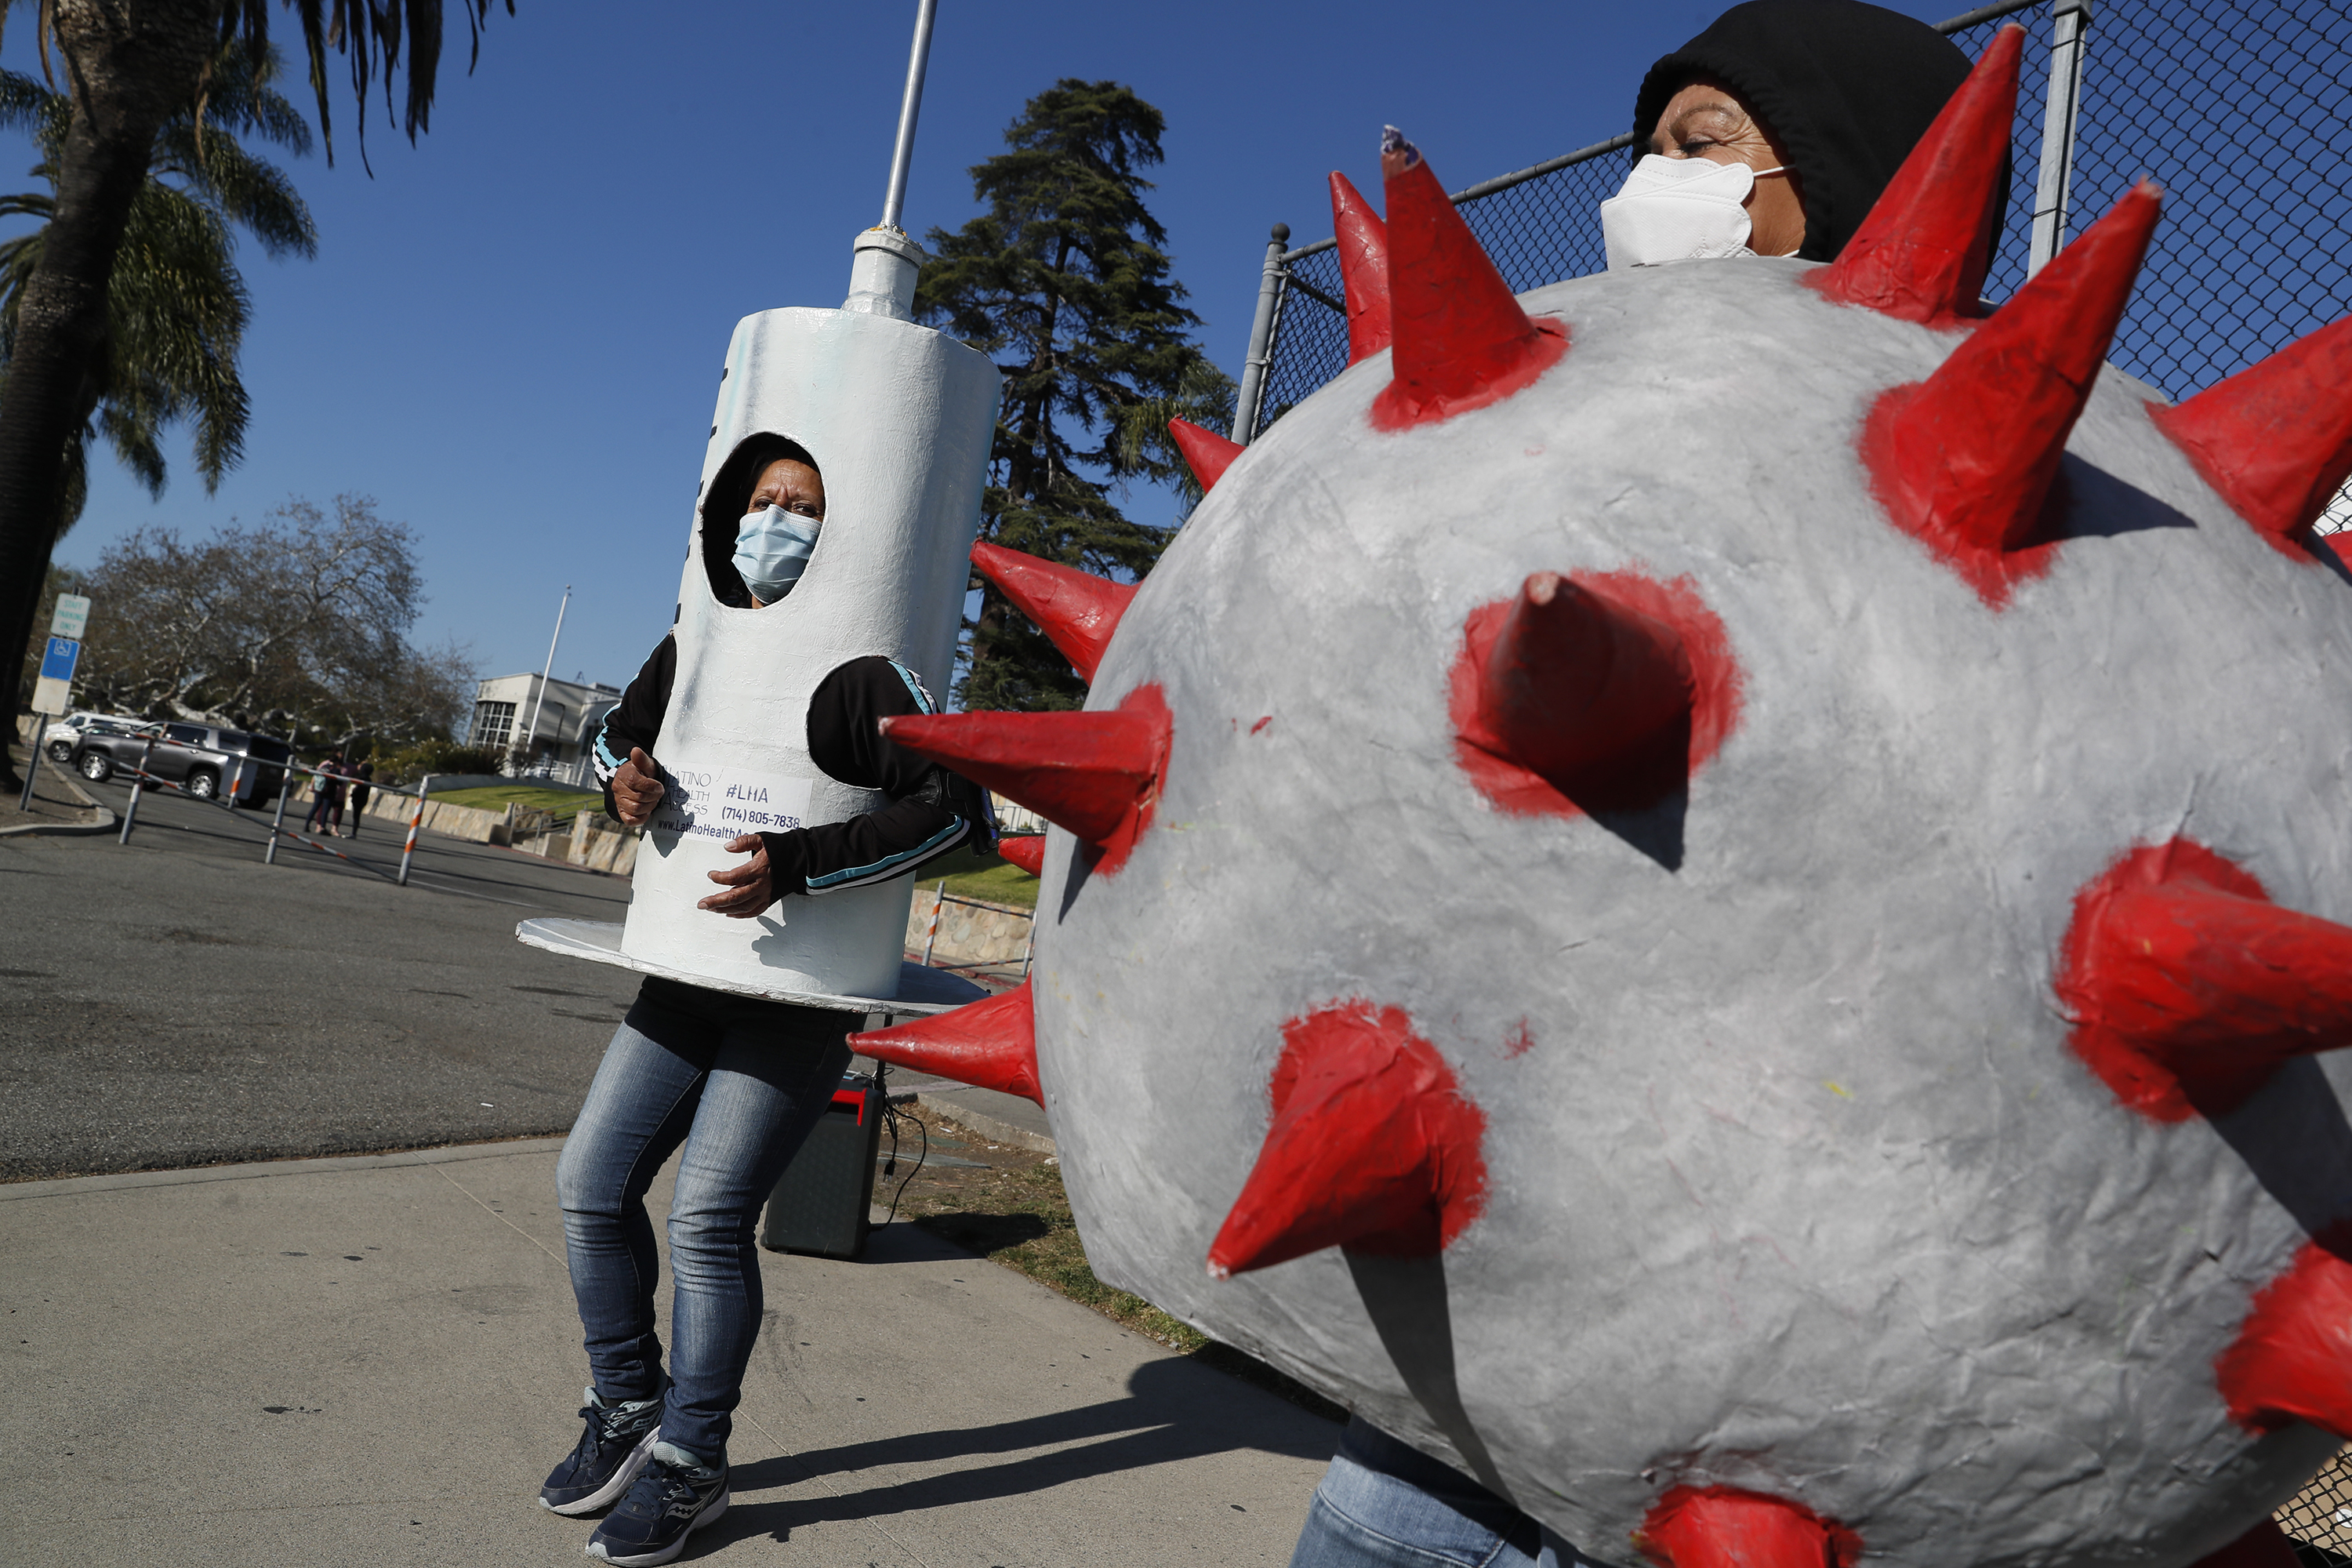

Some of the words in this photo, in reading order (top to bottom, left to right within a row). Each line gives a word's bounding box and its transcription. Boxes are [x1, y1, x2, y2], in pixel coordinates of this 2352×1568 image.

[64, 599, 84, 610] STAFF
[56, 609, 85, 622] PARKING
[60, 621, 76, 631] ONLY
[666, 766, 712, 788] LATINO
[671, 787, 710, 802] HEALTH
[726, 783, 768, 804] #LHA
[722, 806, 746, 823] (714)
[749, 811, 800, 829] 805-7838
